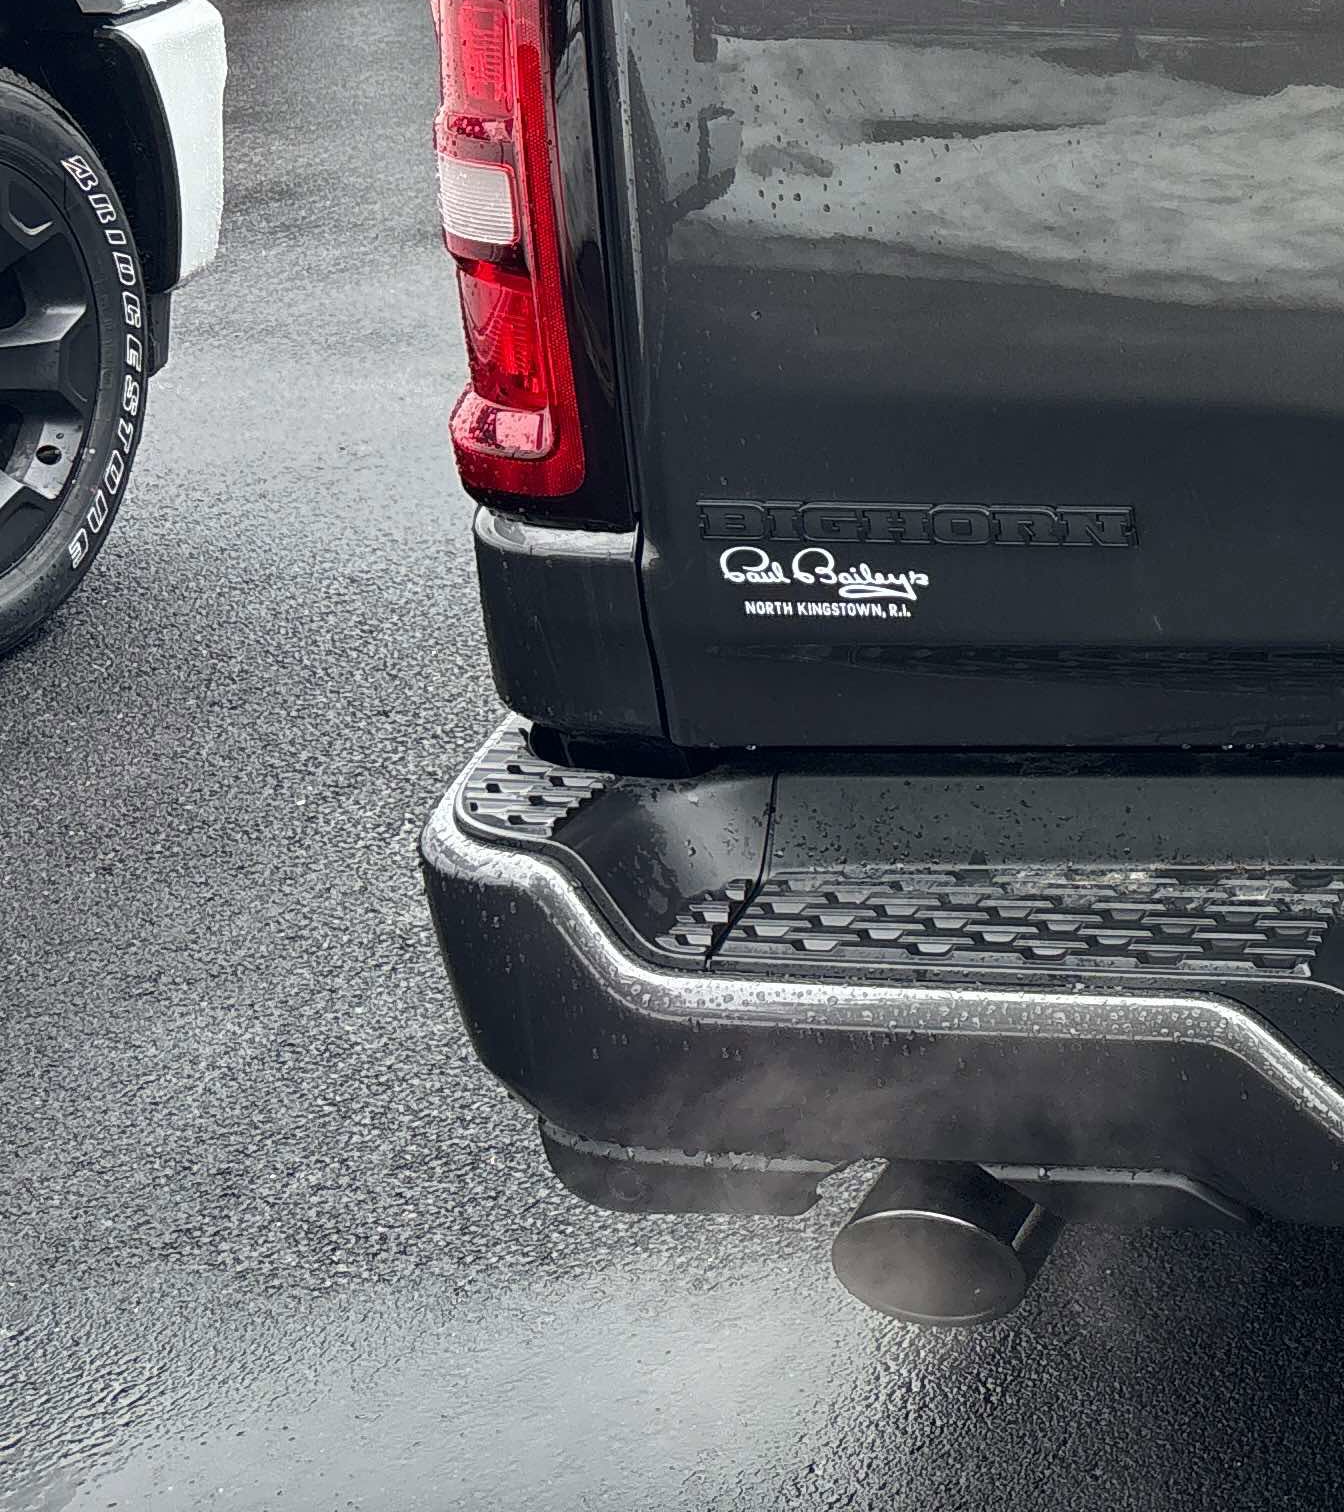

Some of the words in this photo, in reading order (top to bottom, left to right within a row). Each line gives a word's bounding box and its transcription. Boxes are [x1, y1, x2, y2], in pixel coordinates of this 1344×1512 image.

[61, 155, 146, 569] BRIDGESTONE
[696, 499, 1139, 548] BIGHORN
[719, 545, 791, 584] Paul
[791, 547, 930, 601] Bailey's
[744, 600, 793, 616] NORTH
[797, 601, 887, 619] KINGSTOWN,
[889, 603, 912, 617] R.I.
